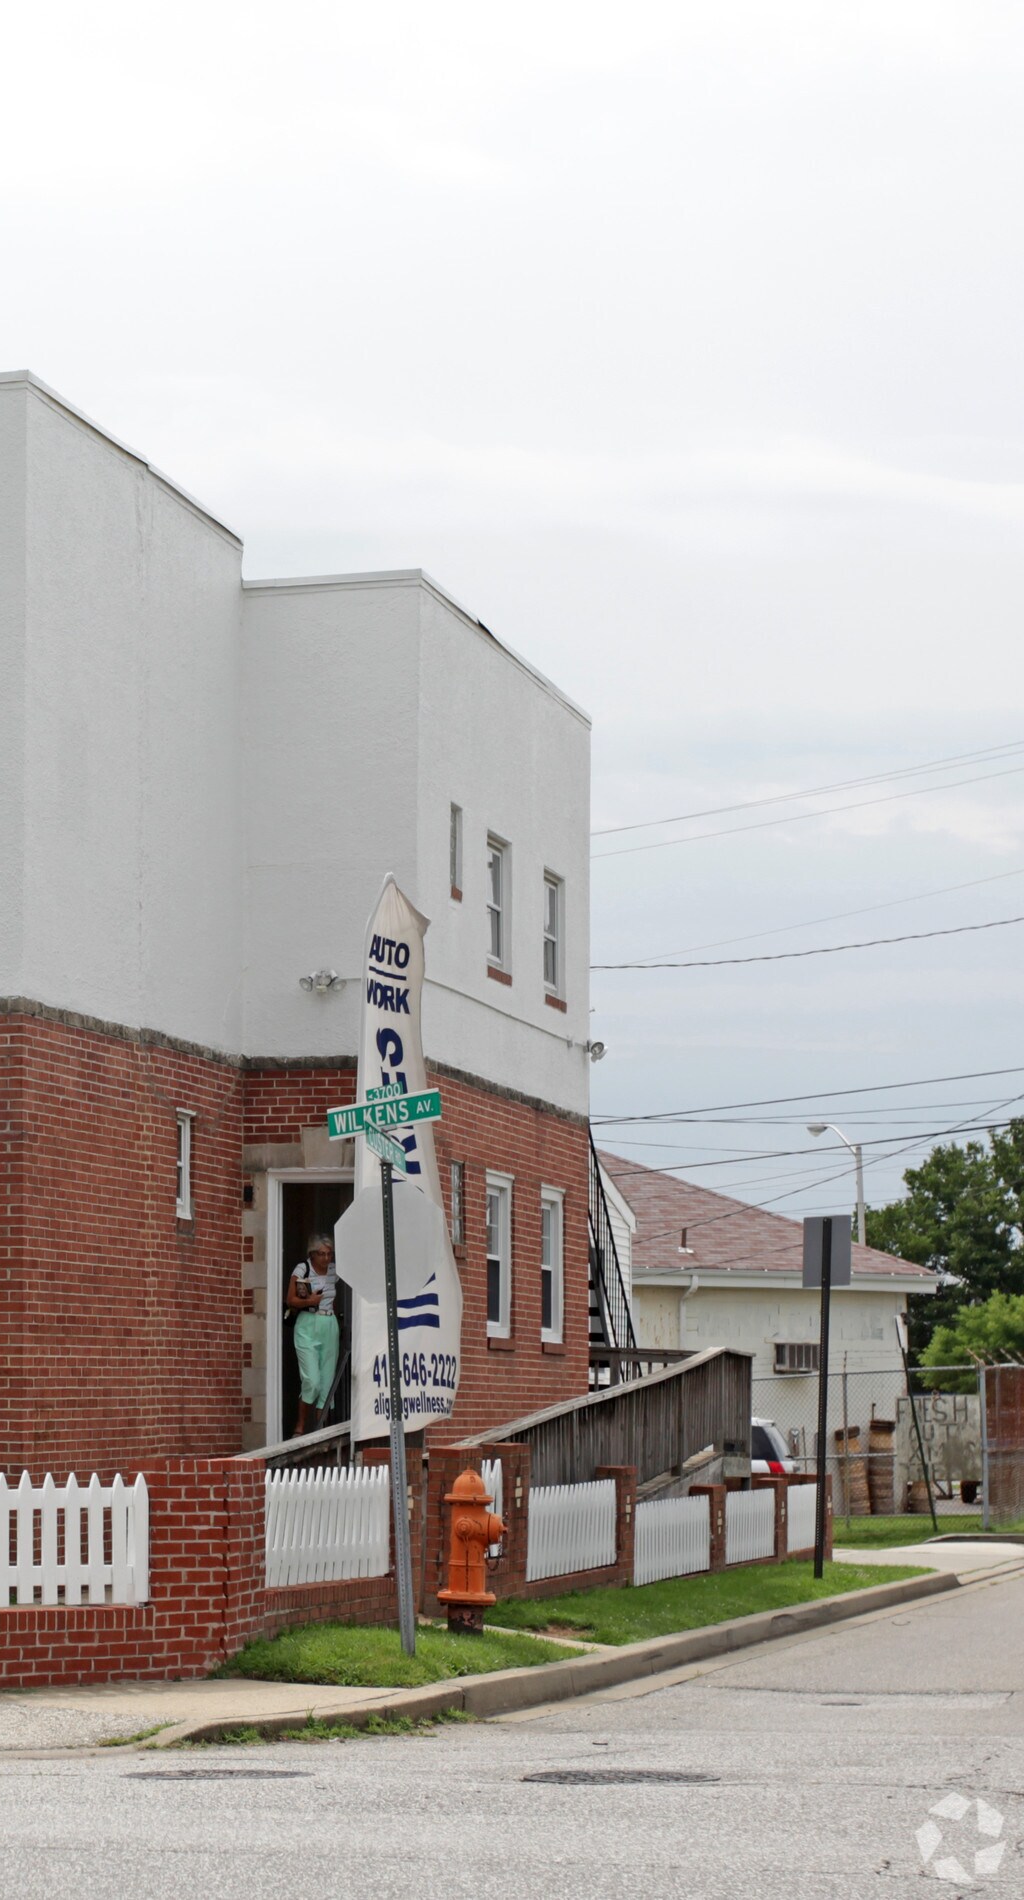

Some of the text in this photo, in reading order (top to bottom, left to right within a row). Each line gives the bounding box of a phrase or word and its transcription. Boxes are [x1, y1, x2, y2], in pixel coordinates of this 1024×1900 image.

[369, 934, 410, 969] AUTO
[373, 1083, 401, 1101] 3700
[334, 1099, 434, 1134] WILKENS AV.
[373, 1352, 456, 1390] 41-646-2222
